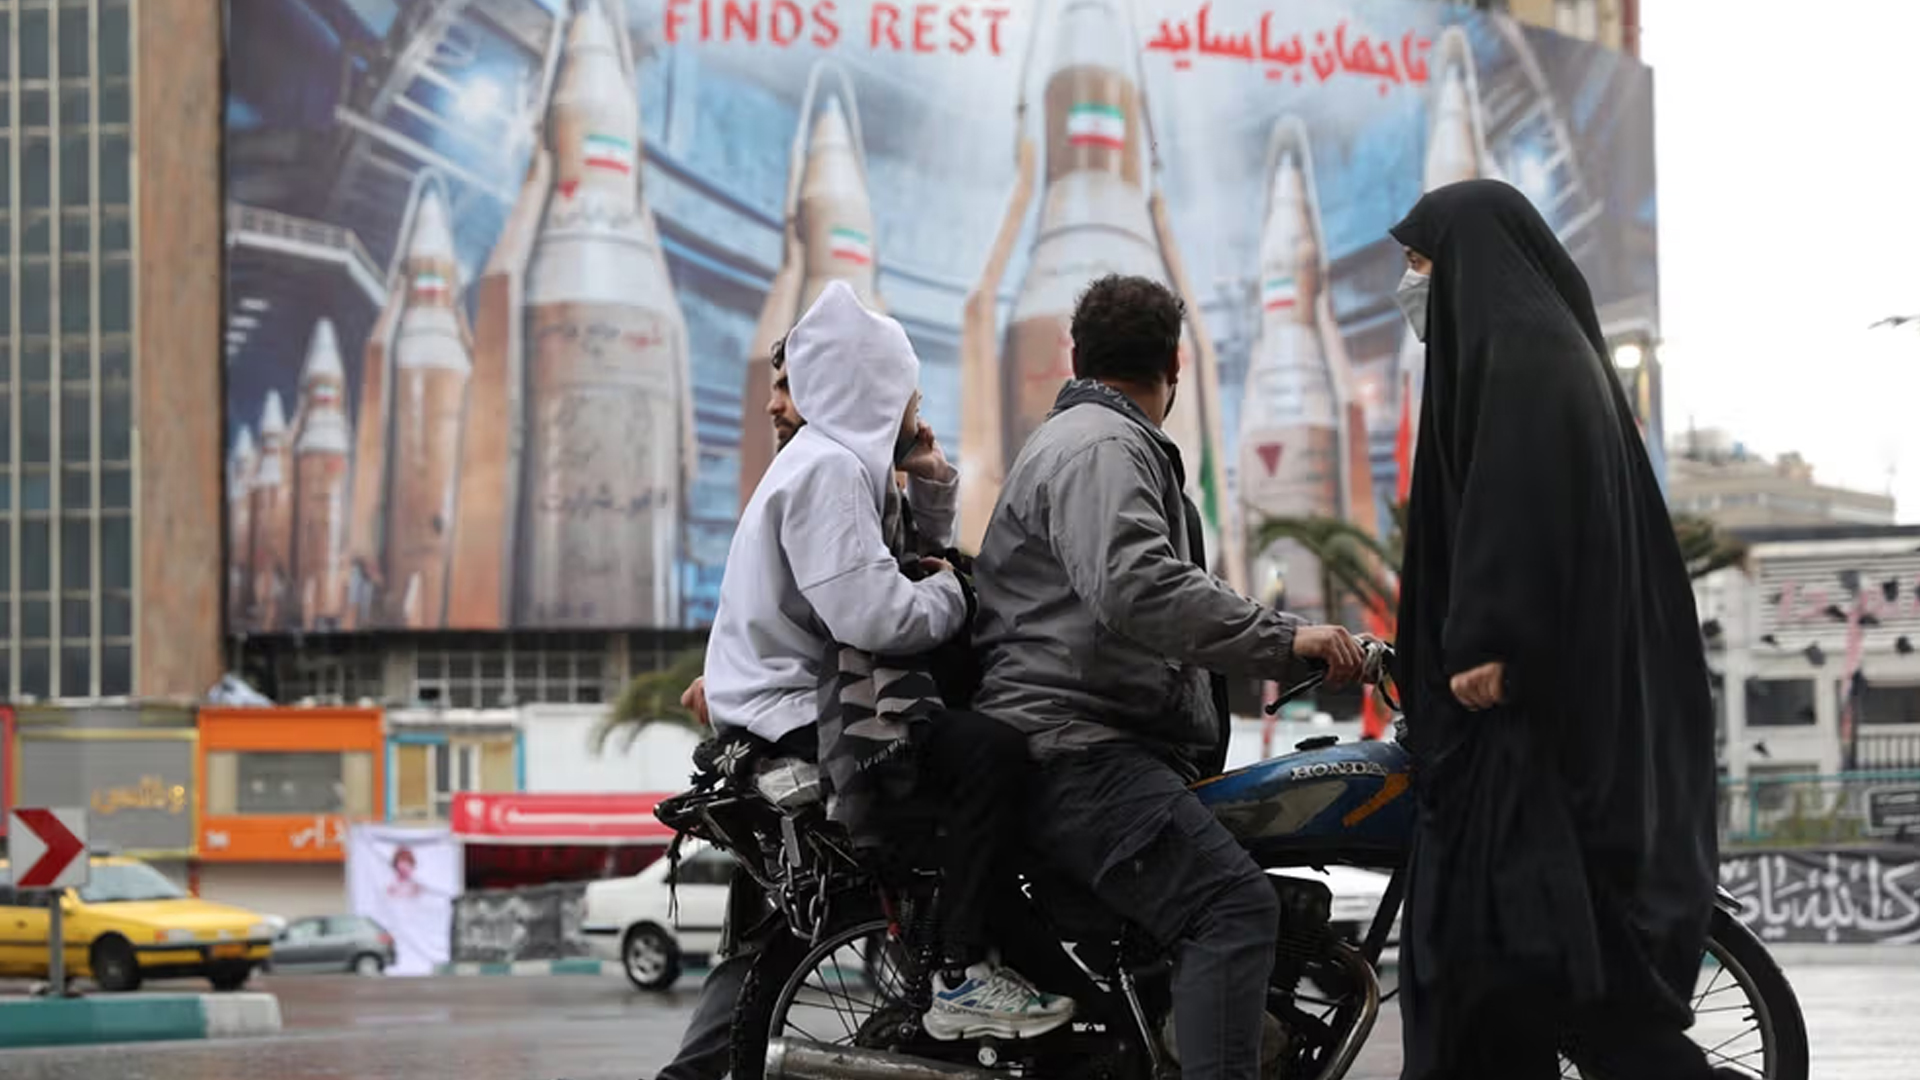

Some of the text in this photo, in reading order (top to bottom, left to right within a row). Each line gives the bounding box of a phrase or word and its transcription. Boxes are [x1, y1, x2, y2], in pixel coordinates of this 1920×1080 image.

[664, 0, 1011, 56] FINDS REST
[1146, 2, 1432, 95] تا جهان بیاساید
[1291, 762, 1388, 780] HONDA
